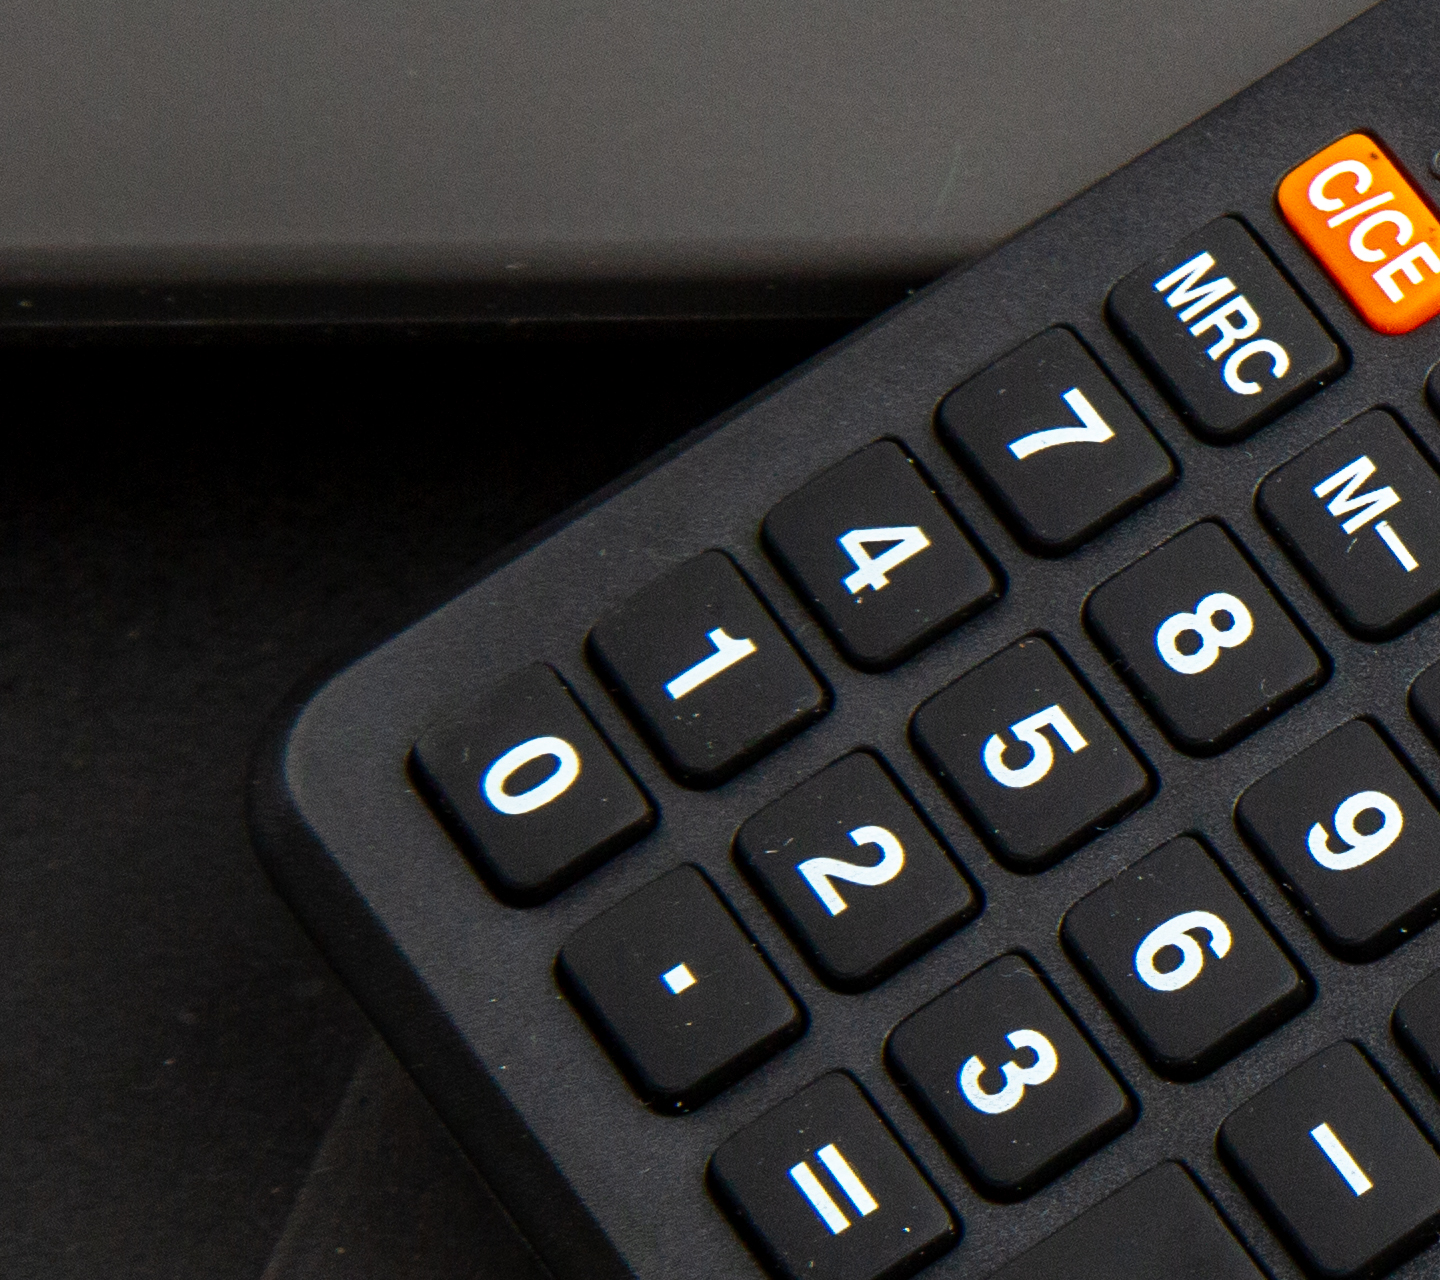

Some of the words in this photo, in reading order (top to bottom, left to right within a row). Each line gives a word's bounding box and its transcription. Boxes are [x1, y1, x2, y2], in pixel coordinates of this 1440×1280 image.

[1154, 250, 1290, 396] MRC
[1008, 386, 1115, 461] 7
[839, 525, 930, 595] 4
[666, 626, 756, 701] 1
[1156, 591, 1254, 676] 8
[483, 735, 580, 816] 0
[983, 703, 1088, 789] 5
[797, 824, 905, 917] 2
[1307, 789, 1404, 872] 9
[1134, 909, 1232, 993] 6
[959, 1027, 1058, 1115] 3
